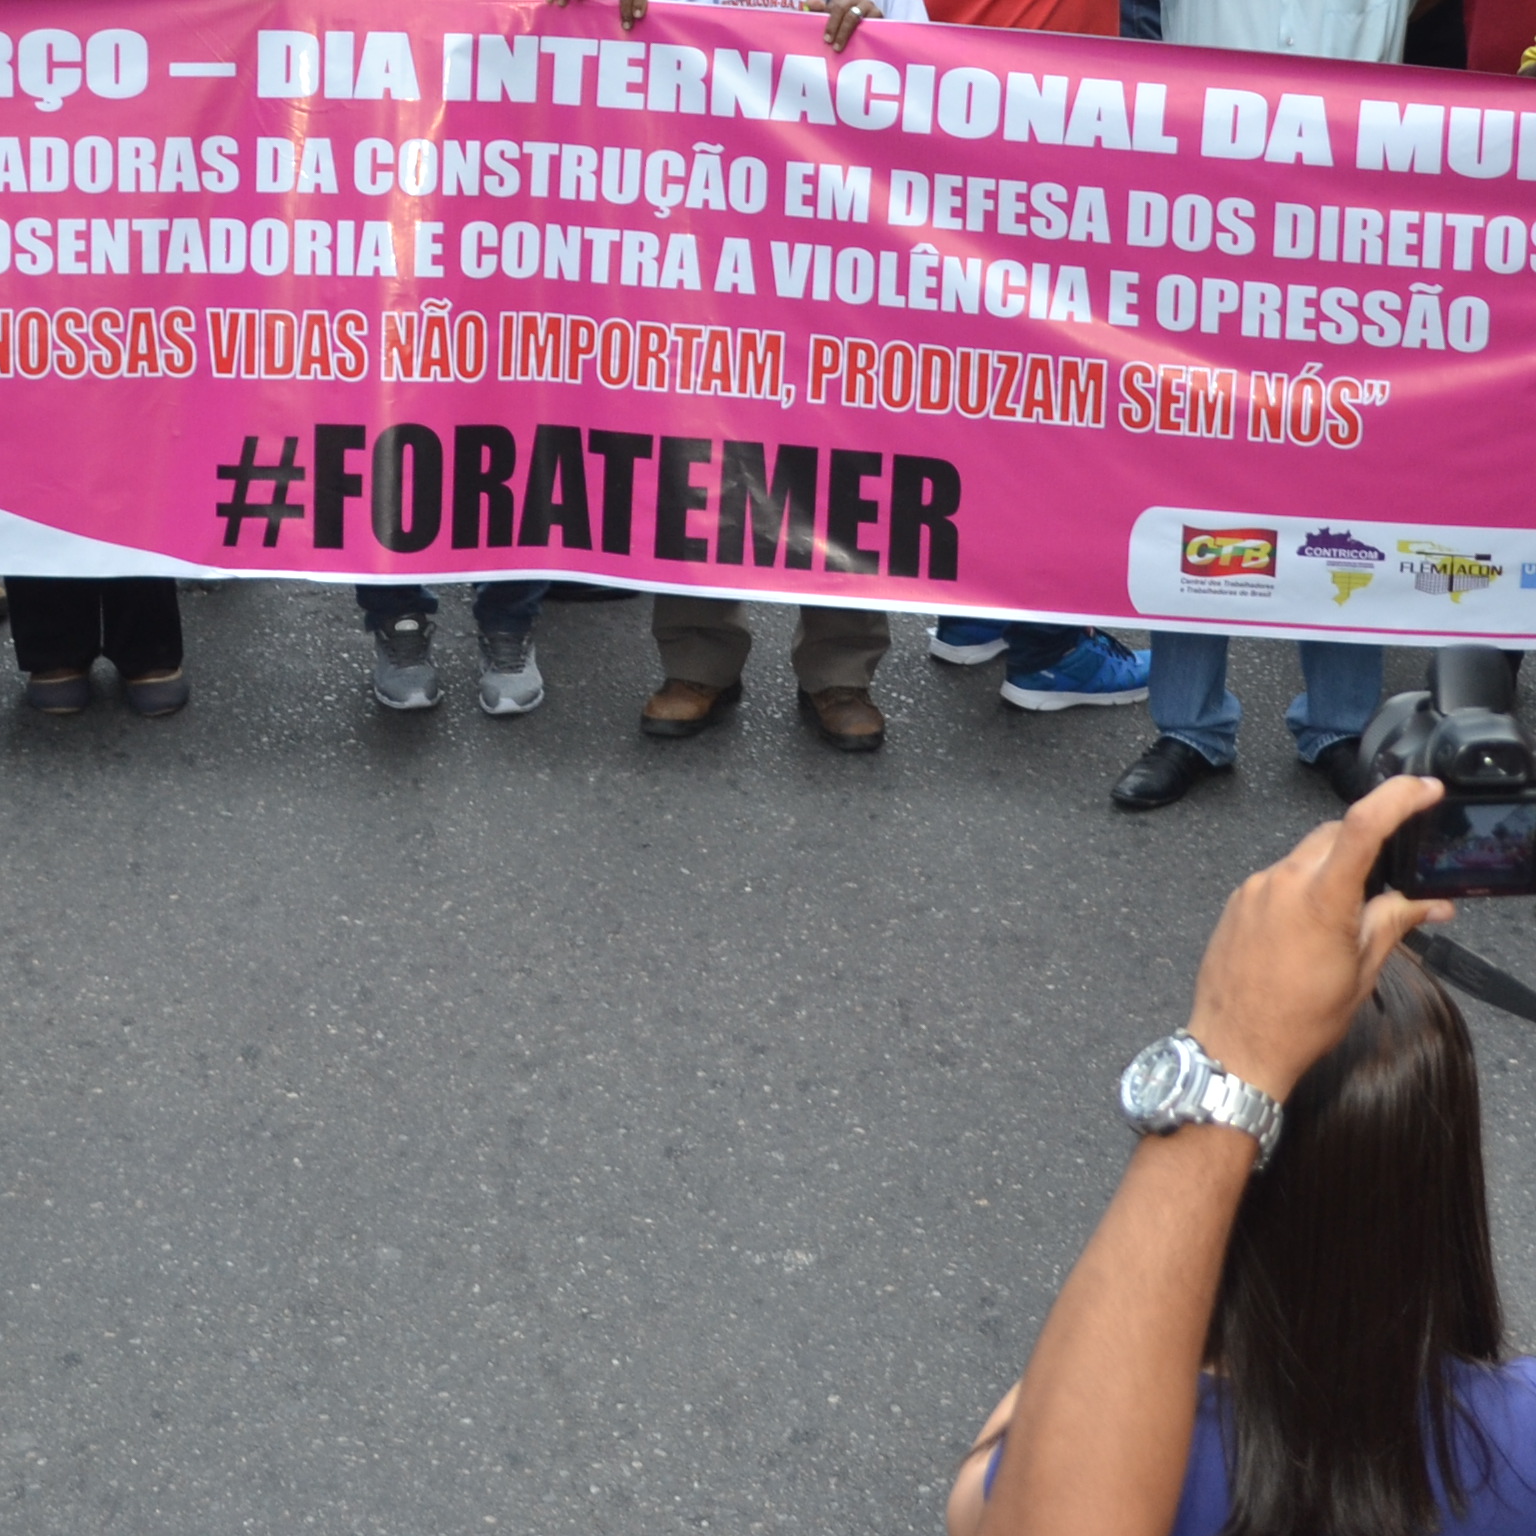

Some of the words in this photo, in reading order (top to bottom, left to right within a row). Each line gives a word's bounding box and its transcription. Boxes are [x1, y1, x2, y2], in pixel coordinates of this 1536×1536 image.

[255, 28, 422, 102] DIA
[441, 31, 1177, 155] INTERNACIONAL
[1200, 86, 1335, 168] DA
[256, 136, 340, 195] DA
[353, 138, 768, 220] CONSTRUÇÃO
[784, 160, 873, 224] EM
[886, 168, 1112, 245] DEFESA
[1126, 188, 1257, 256] DOS
[412, 220, 444, 278] E
[460, 220, 702, 291] CONTRA
[714, 236, 756, 295] A
[769, 240, 1093, 325] VIOLÊNCIA
[1107, 268, 1140, 326] E
[1155, 272, 1491, 353] OPRESSÃO
[205, 306, 369, 382] VIDAS
[380, 297, 488, 384] NÃO
[498, 310, 796, 410] IMPORTAM,
[806, 333, 1108, 430] PRODUZAM
[1120, 360, 1235, 440] SEM
[215, 421, 963, 583] #FORATEMER
[1185, 534, 1272, 570] CTB
[1304, 546, 1379, 560] CONTRICOM
